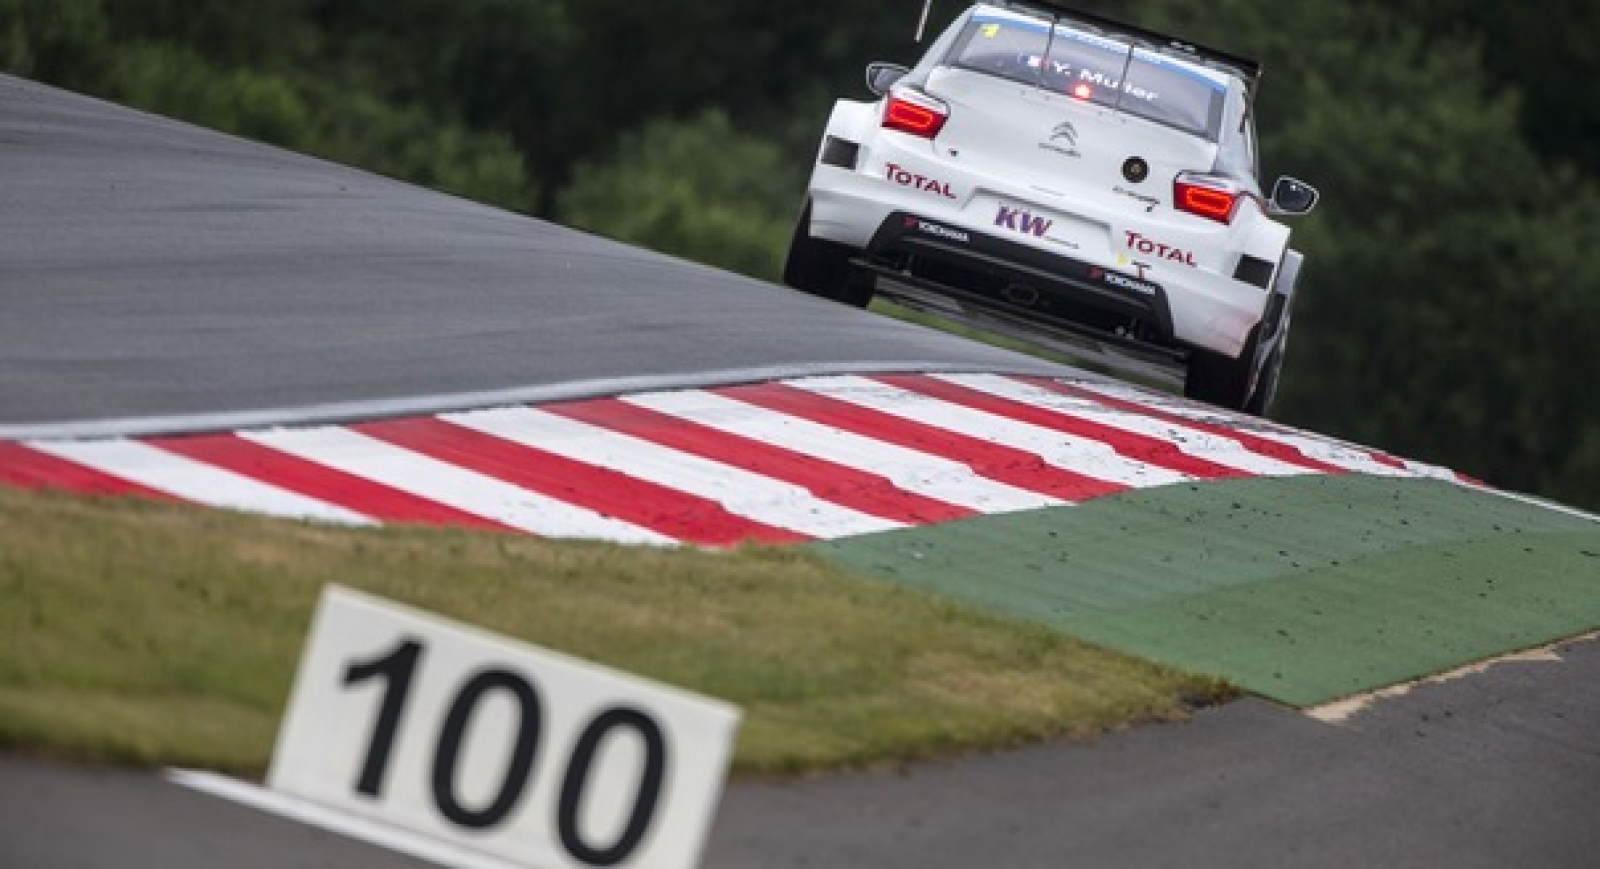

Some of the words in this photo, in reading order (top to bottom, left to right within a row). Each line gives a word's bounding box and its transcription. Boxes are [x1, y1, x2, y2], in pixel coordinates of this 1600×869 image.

[885, 162, 957, 199] TOTAL
[994, 206, 1053, 238] KW
[1125, 230, 1197, 268] TOTAL
[338, 636, 671, 867] 100
